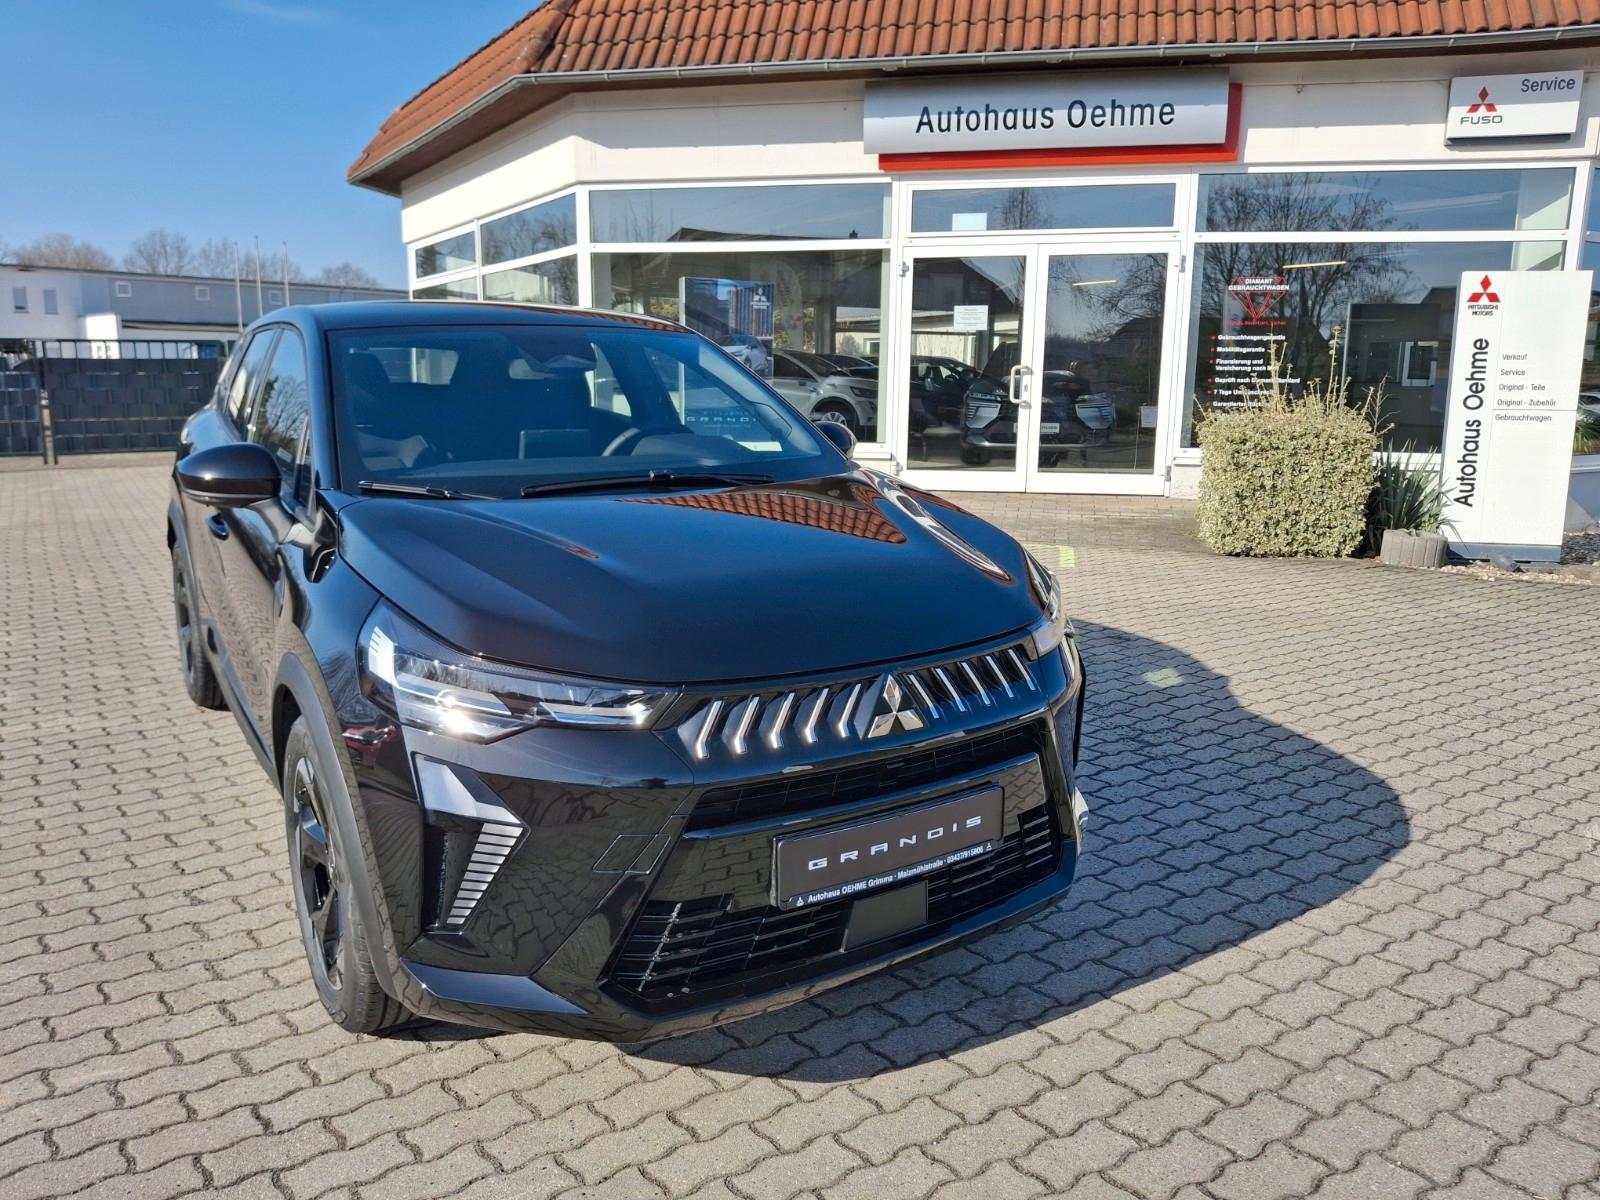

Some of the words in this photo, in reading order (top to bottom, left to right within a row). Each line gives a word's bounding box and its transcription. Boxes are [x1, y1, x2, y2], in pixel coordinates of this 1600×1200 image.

[1521, 77, 1576, 93] Service
[915, 104, 1055, 133] Autohaus
[1066, 99, 1176, 129] Oehme
[1460, 115, 1503, 125] FUSO
[1502, 353, 1528, 361] Verkauf
[1463, 337, 1490, 411] Oehme
[1500, 368, 1526, 376] Service
[1498, 383, 1525, 392] Original
[1530, 383, 1546, 391] Teile
[1497, 398, 1523, 407] Original
[1528, 398, 1557, 406] Zubehör
[1495, 413, 1552, 423] Gebrauchtwagen
[1453, 419, 1481, 507] Autohaus
[807, 815, 982, 871] GRANDIS
[807, 889, 841, 904] Autohaus
[841, 880, 867, 894] OEHME
[867, 874, 893, 887] Grimma
